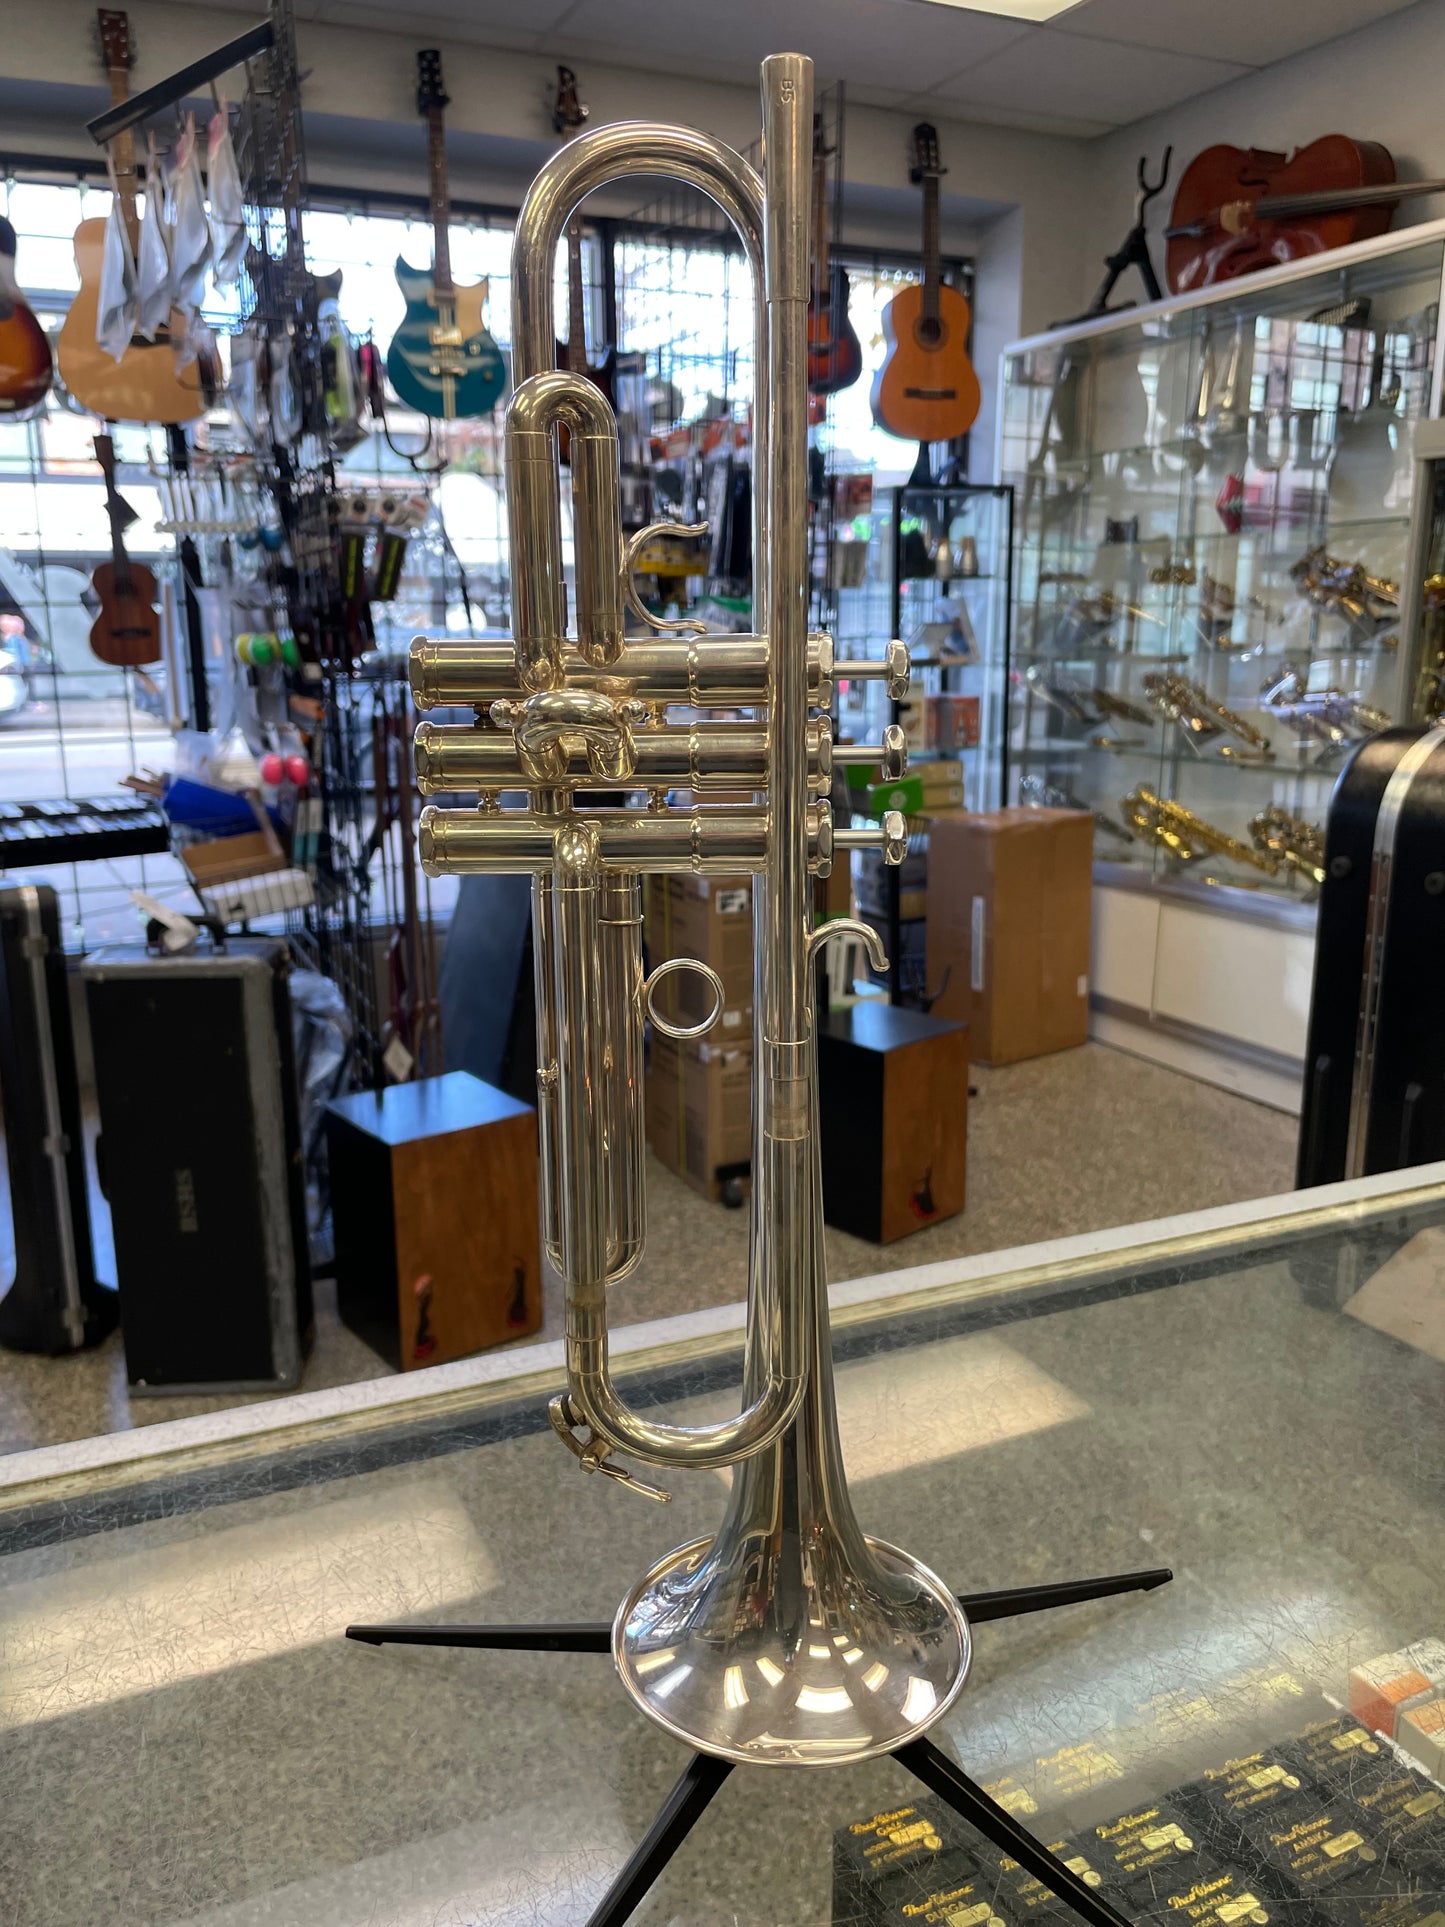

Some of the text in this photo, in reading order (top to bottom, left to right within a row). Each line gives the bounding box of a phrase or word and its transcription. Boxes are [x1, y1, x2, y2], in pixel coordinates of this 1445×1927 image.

[780, 78, 797, 105] B5
[1293, 1829, 1333, 1854] AMBIKA
[1290, 1853, 1319, 1869] MODEL
[925, 1901, 969, 1923] DURGA
